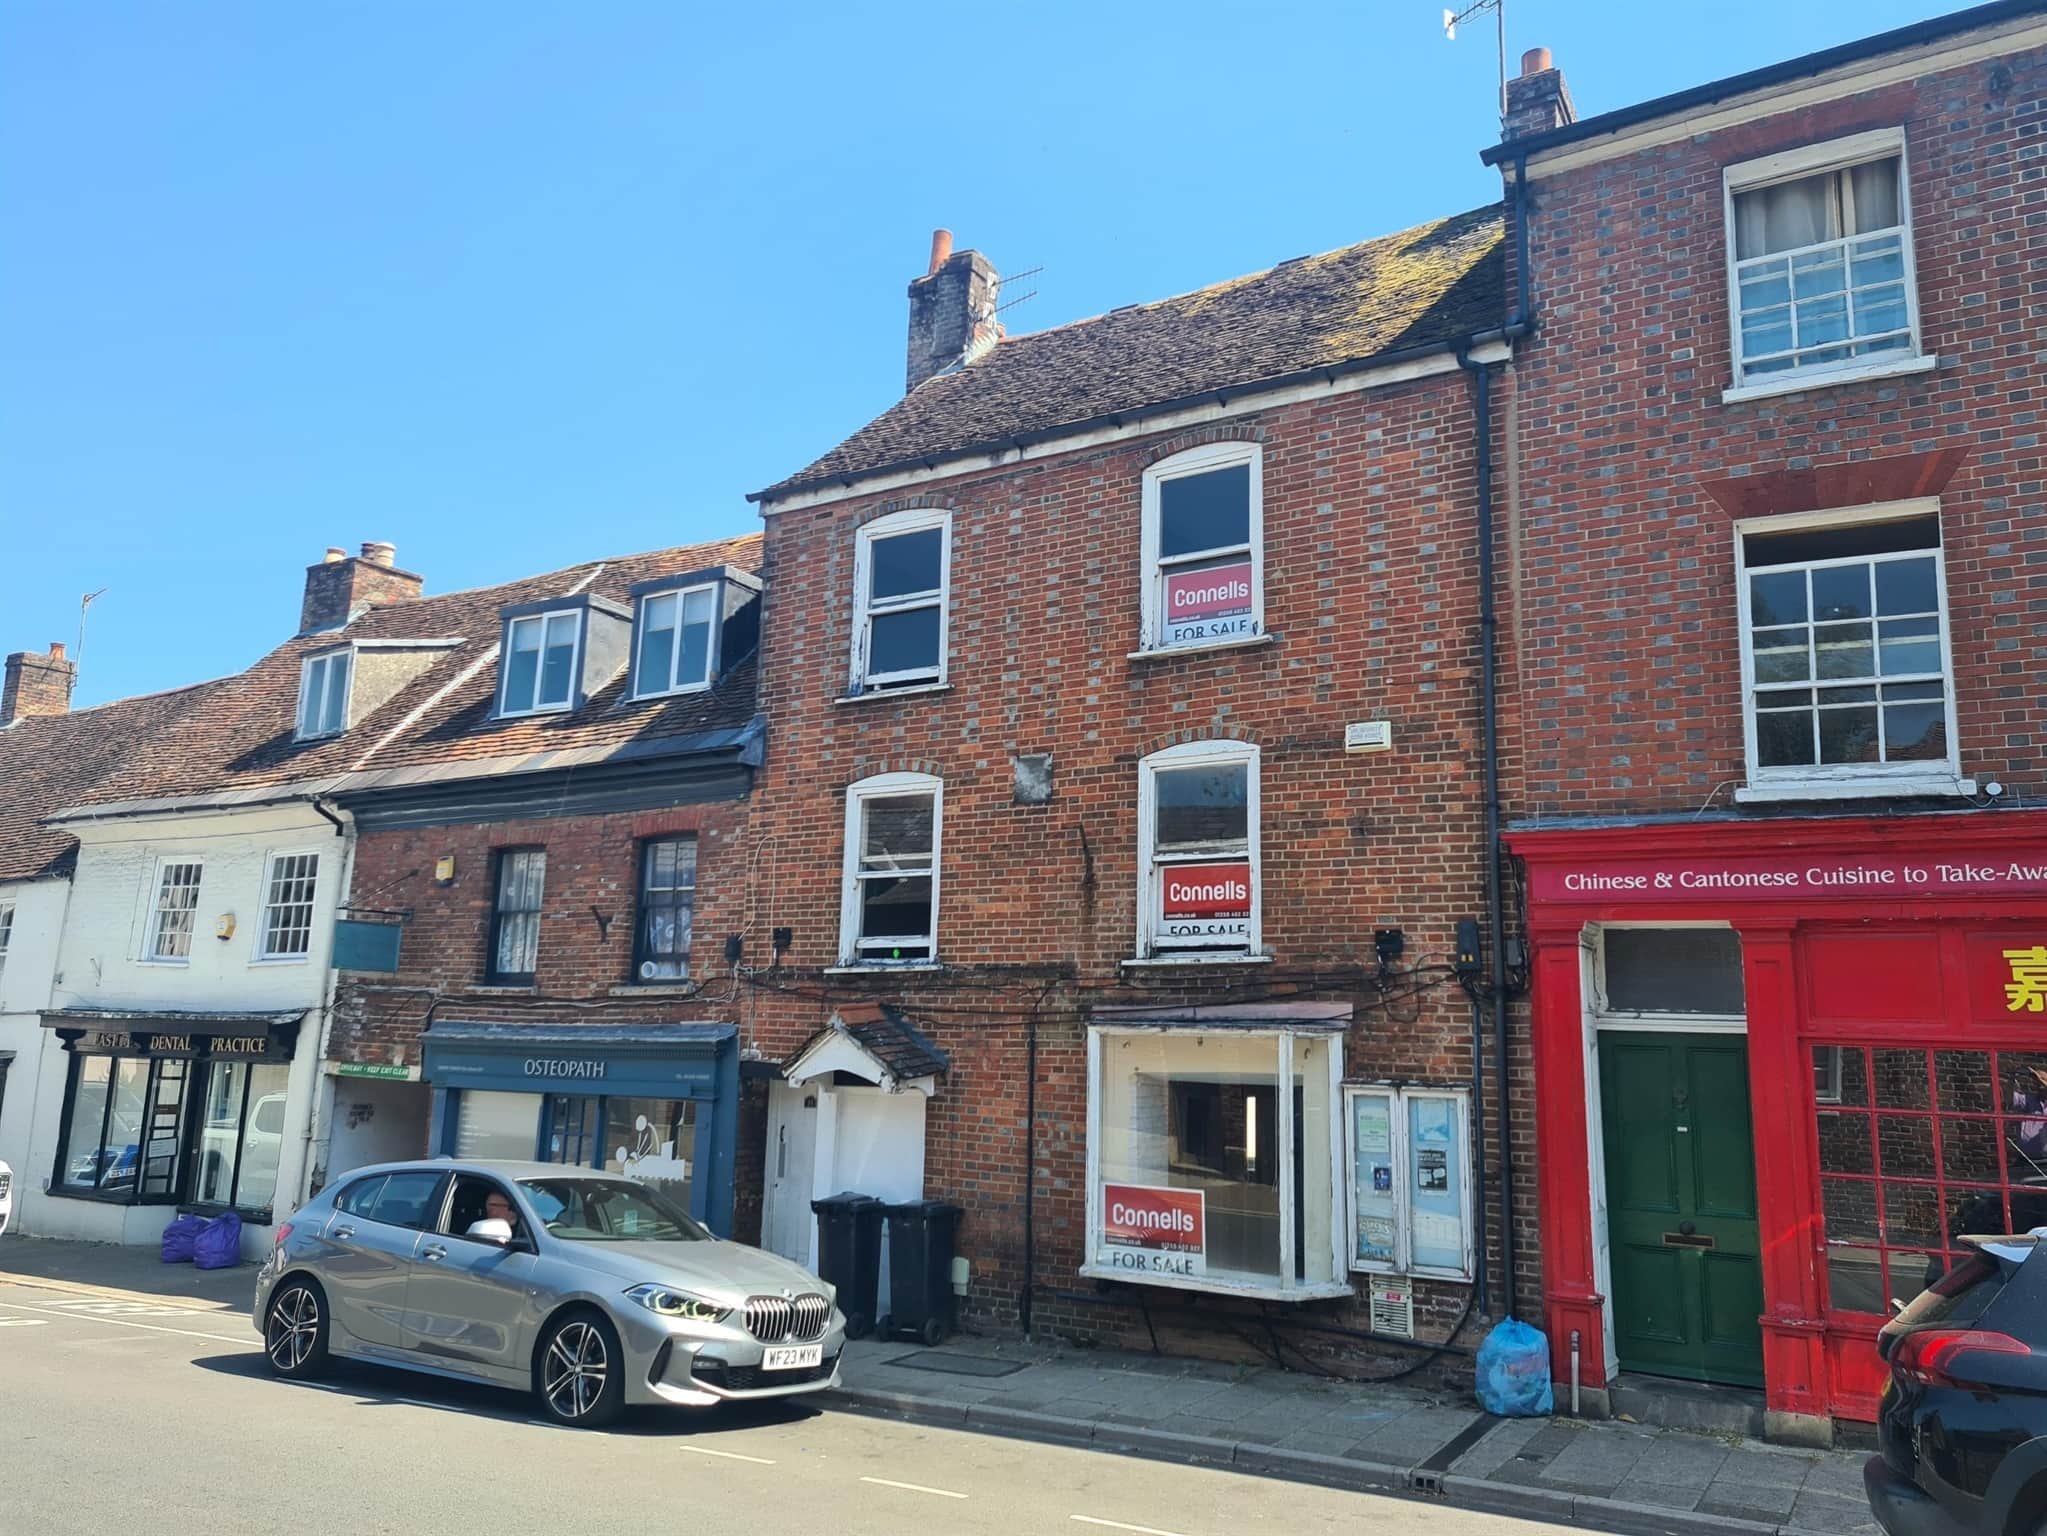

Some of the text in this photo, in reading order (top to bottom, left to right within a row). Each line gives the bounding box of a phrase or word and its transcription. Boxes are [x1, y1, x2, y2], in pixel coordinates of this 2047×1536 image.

[1175, 581, 1248, 606] Connells
[1174, 626, 1205, 641] FOR
[1564, 873, 1648, 890] Chinese
[1653, 872, 1673, 889] &
[1679, 870, 1799, 888] Cantonese
[1805, 866, 1895, 885] Cuisine
[1903, 866, 1928, 883] to
[1170, 881, 1246, 901] Connells
[150, 1035, 192, 1051] DENTAL
[210, 1037, 265, 1053] PRACTICE
[524, 1059, 604, 1077] OSTEOPATH
[1112, 1203, 1194, 1232] Connells
[1112, 1252, 1194, 1276] FOR SALE
[769, 1350, 797, 1366] WF23
